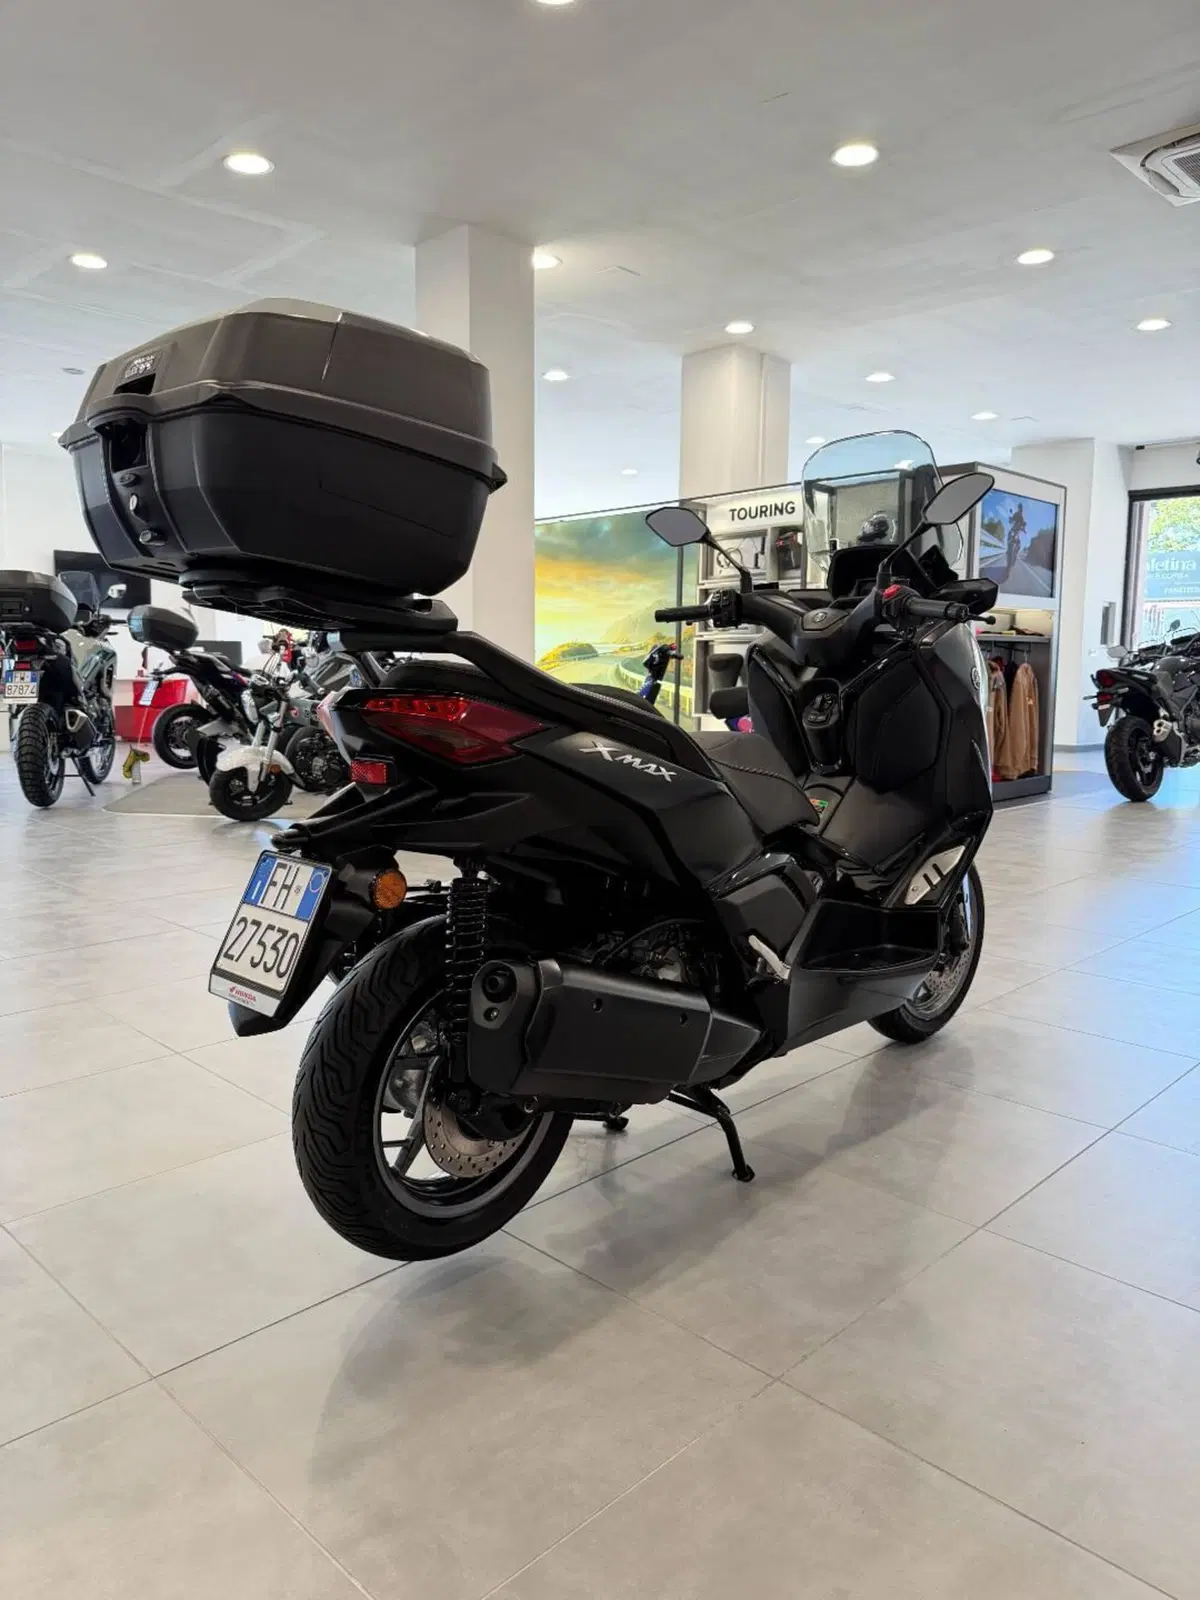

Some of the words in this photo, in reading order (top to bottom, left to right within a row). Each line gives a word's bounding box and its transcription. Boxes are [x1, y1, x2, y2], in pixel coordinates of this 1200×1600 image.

[729, 501, 796, 521] TOURING
[260, 861, 300, 910] FH
[223, 916, 300, 979] 27530
[234, 989, 257, 1003] HONDA
